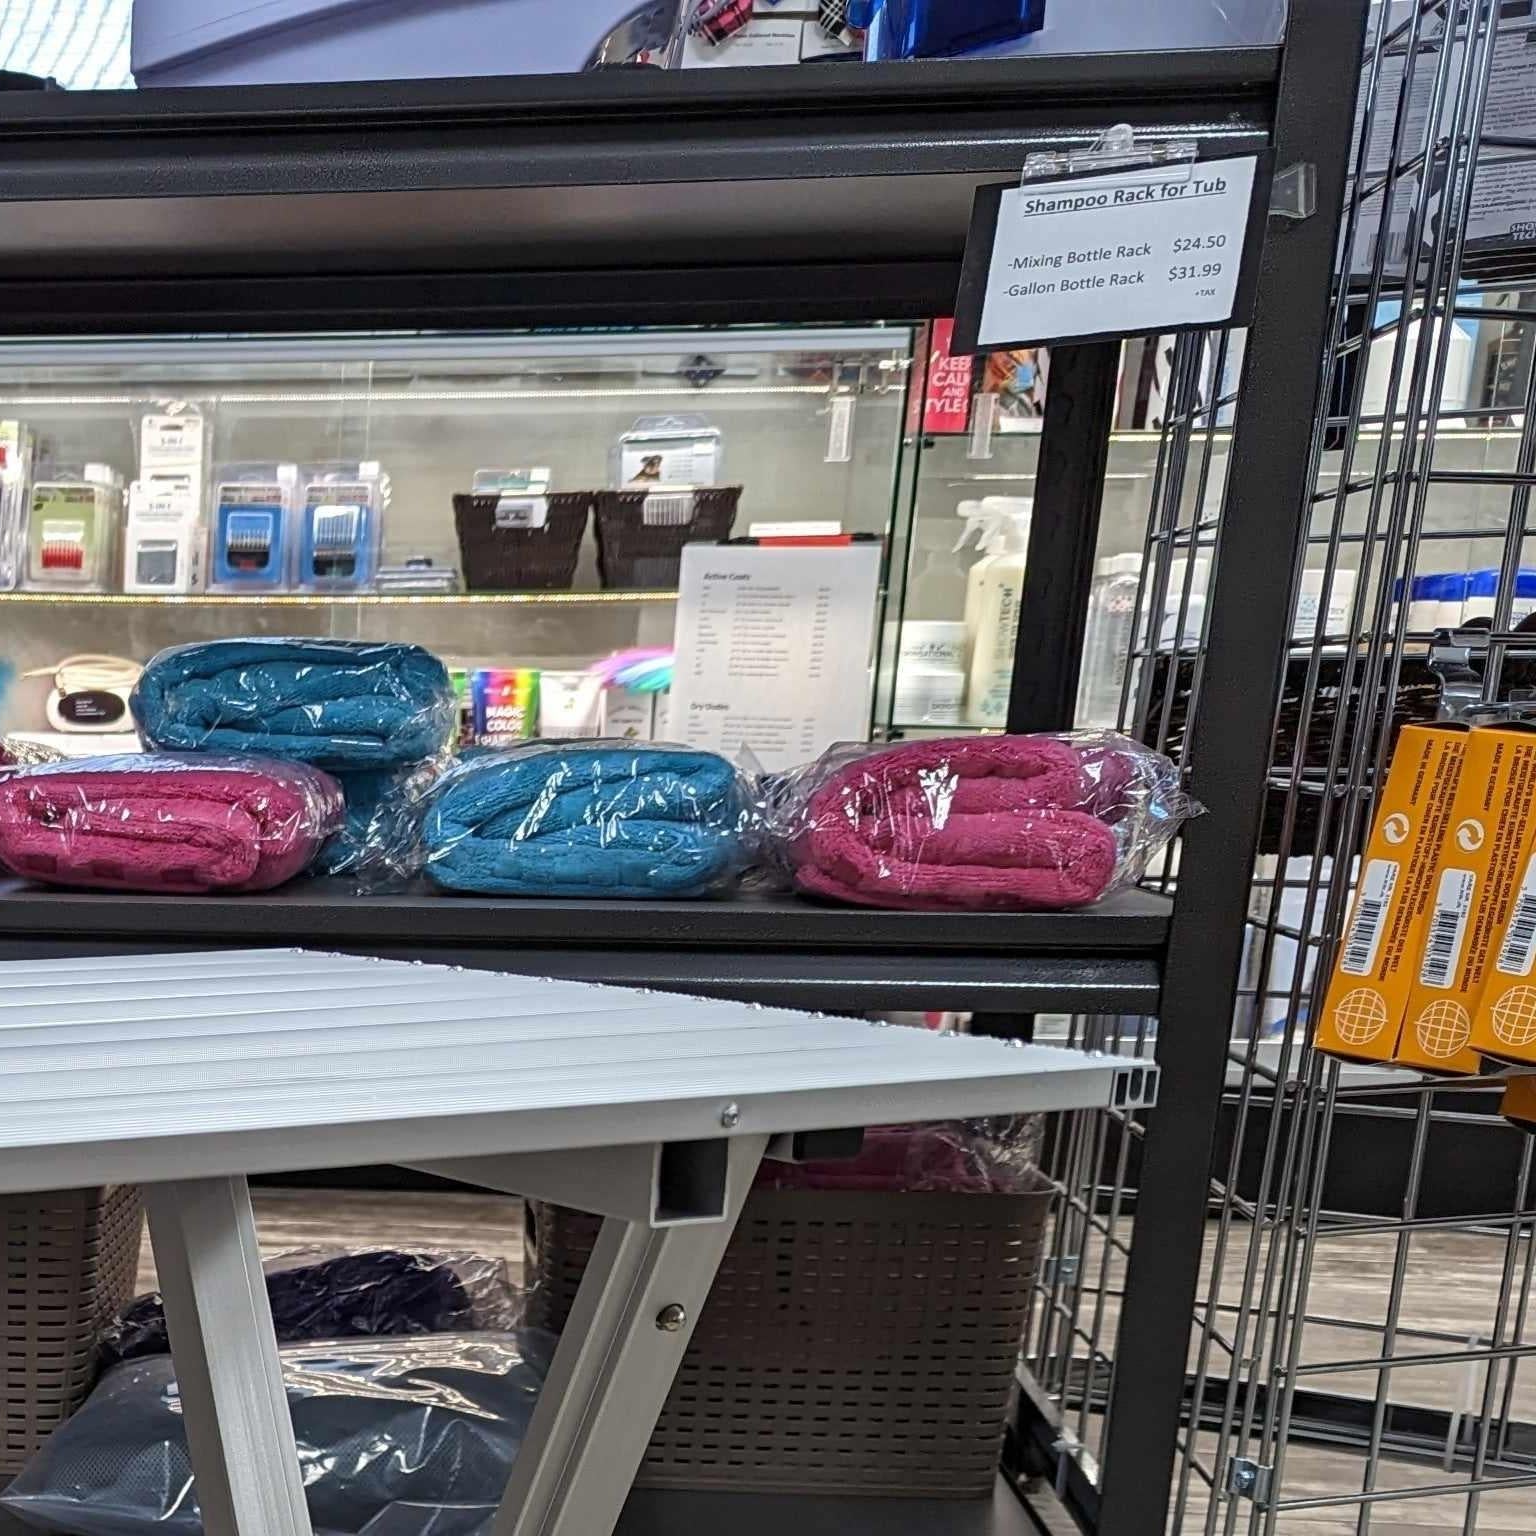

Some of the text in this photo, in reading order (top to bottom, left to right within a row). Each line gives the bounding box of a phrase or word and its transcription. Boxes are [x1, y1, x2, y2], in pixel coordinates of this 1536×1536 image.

[1024, 177, 1227, 215] Shampoo Rack for Tub
[1007, 234, 1226, 271] -Mixing Bottle Rack $24.50
[1003, 263, 1221, 299] -Gallon Bottle Rack $31.99
[1195, 288, 1215, 297] +TAX
